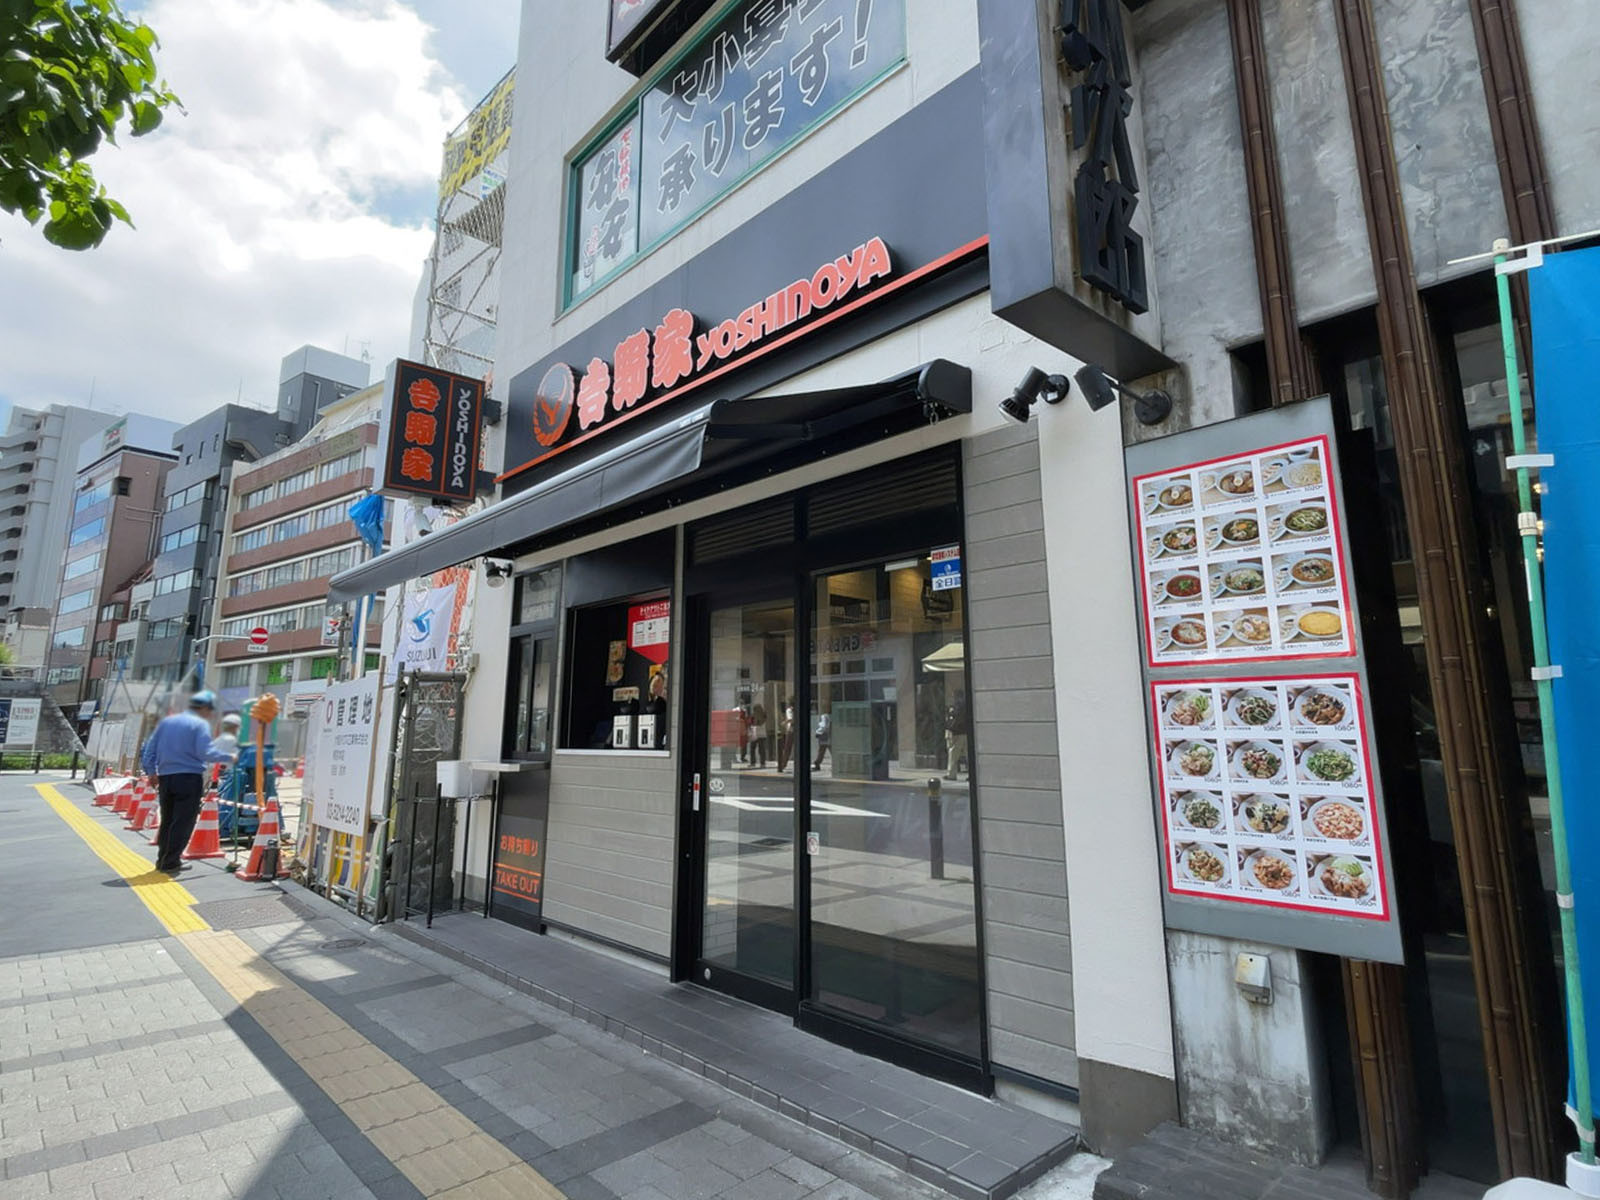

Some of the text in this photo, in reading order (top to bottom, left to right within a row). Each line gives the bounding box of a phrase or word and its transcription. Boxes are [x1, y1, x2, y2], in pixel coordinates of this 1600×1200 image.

[695, 235, 893, 373] YOSHINOYA
[577, 307, 694, 431] 吉野家
[401, 378, 441, 482] 吉野家
[451, 387, 472, 489] YOSHINOYA
[495, 869, 541, 895] TAKE OUT
[500, 835, 539, 857] お持ち帰り
